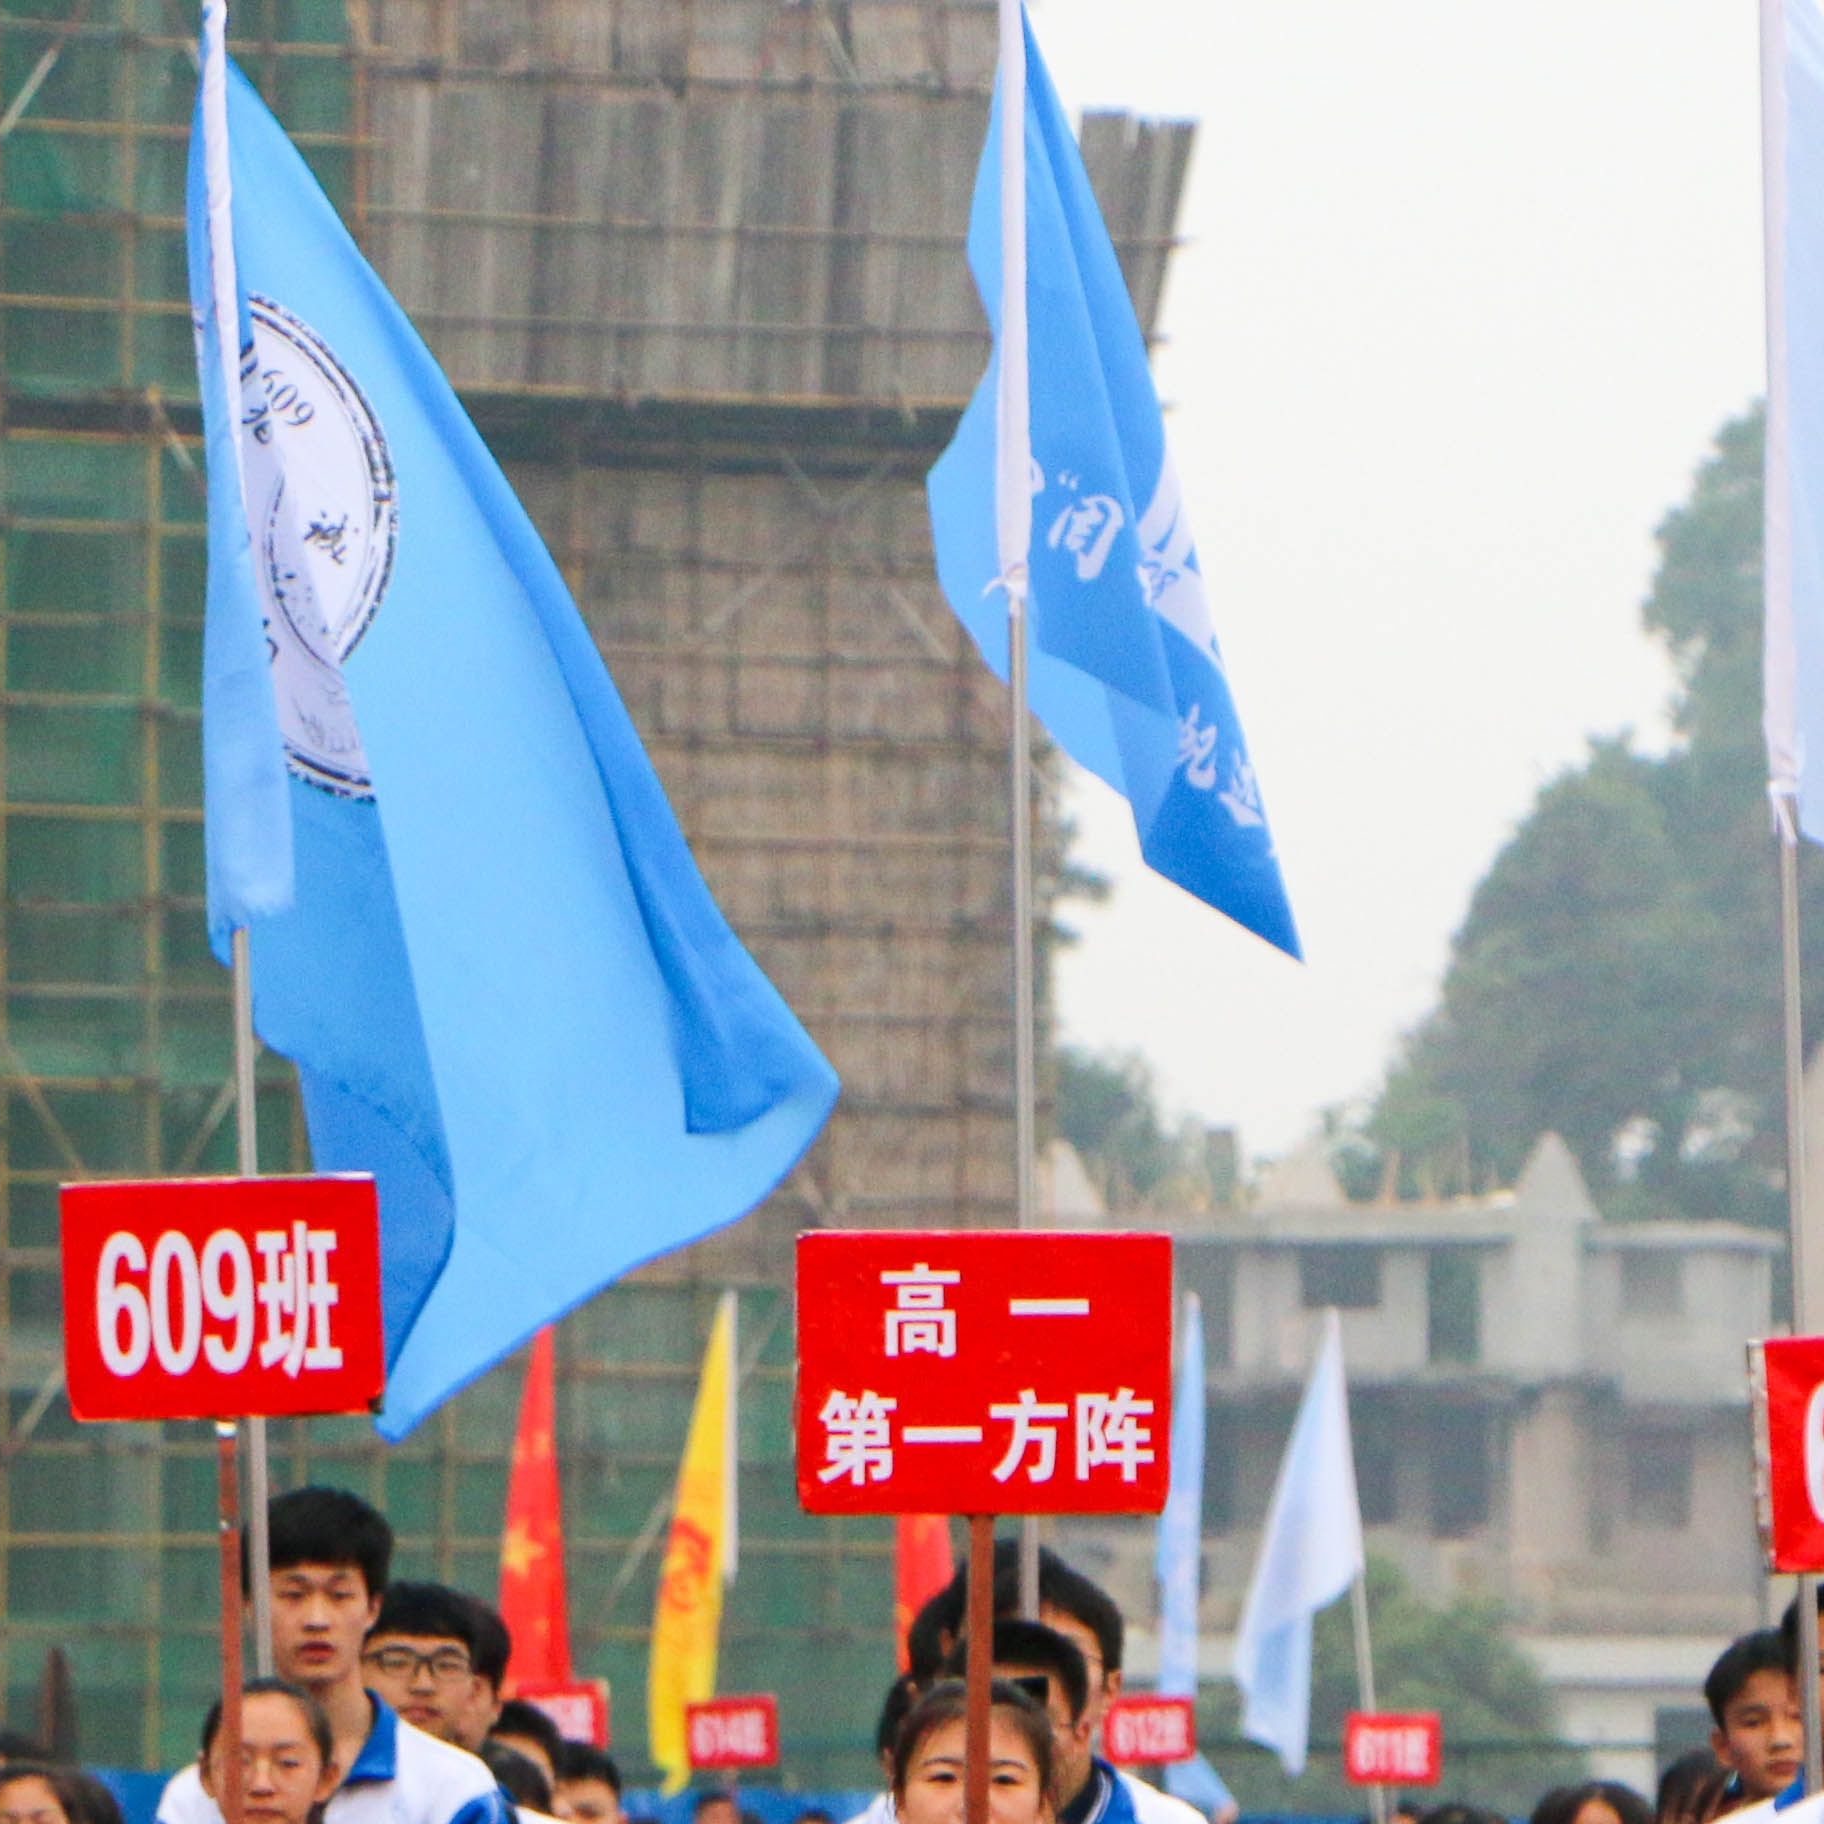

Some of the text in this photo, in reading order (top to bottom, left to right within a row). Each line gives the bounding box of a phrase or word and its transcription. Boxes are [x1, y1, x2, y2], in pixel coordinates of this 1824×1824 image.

[96, 1221, 343, 1380] 609班
[880, 1263, 1090, 1357] 高一
[818, 1390, 1156, 1486] 第一方阵
